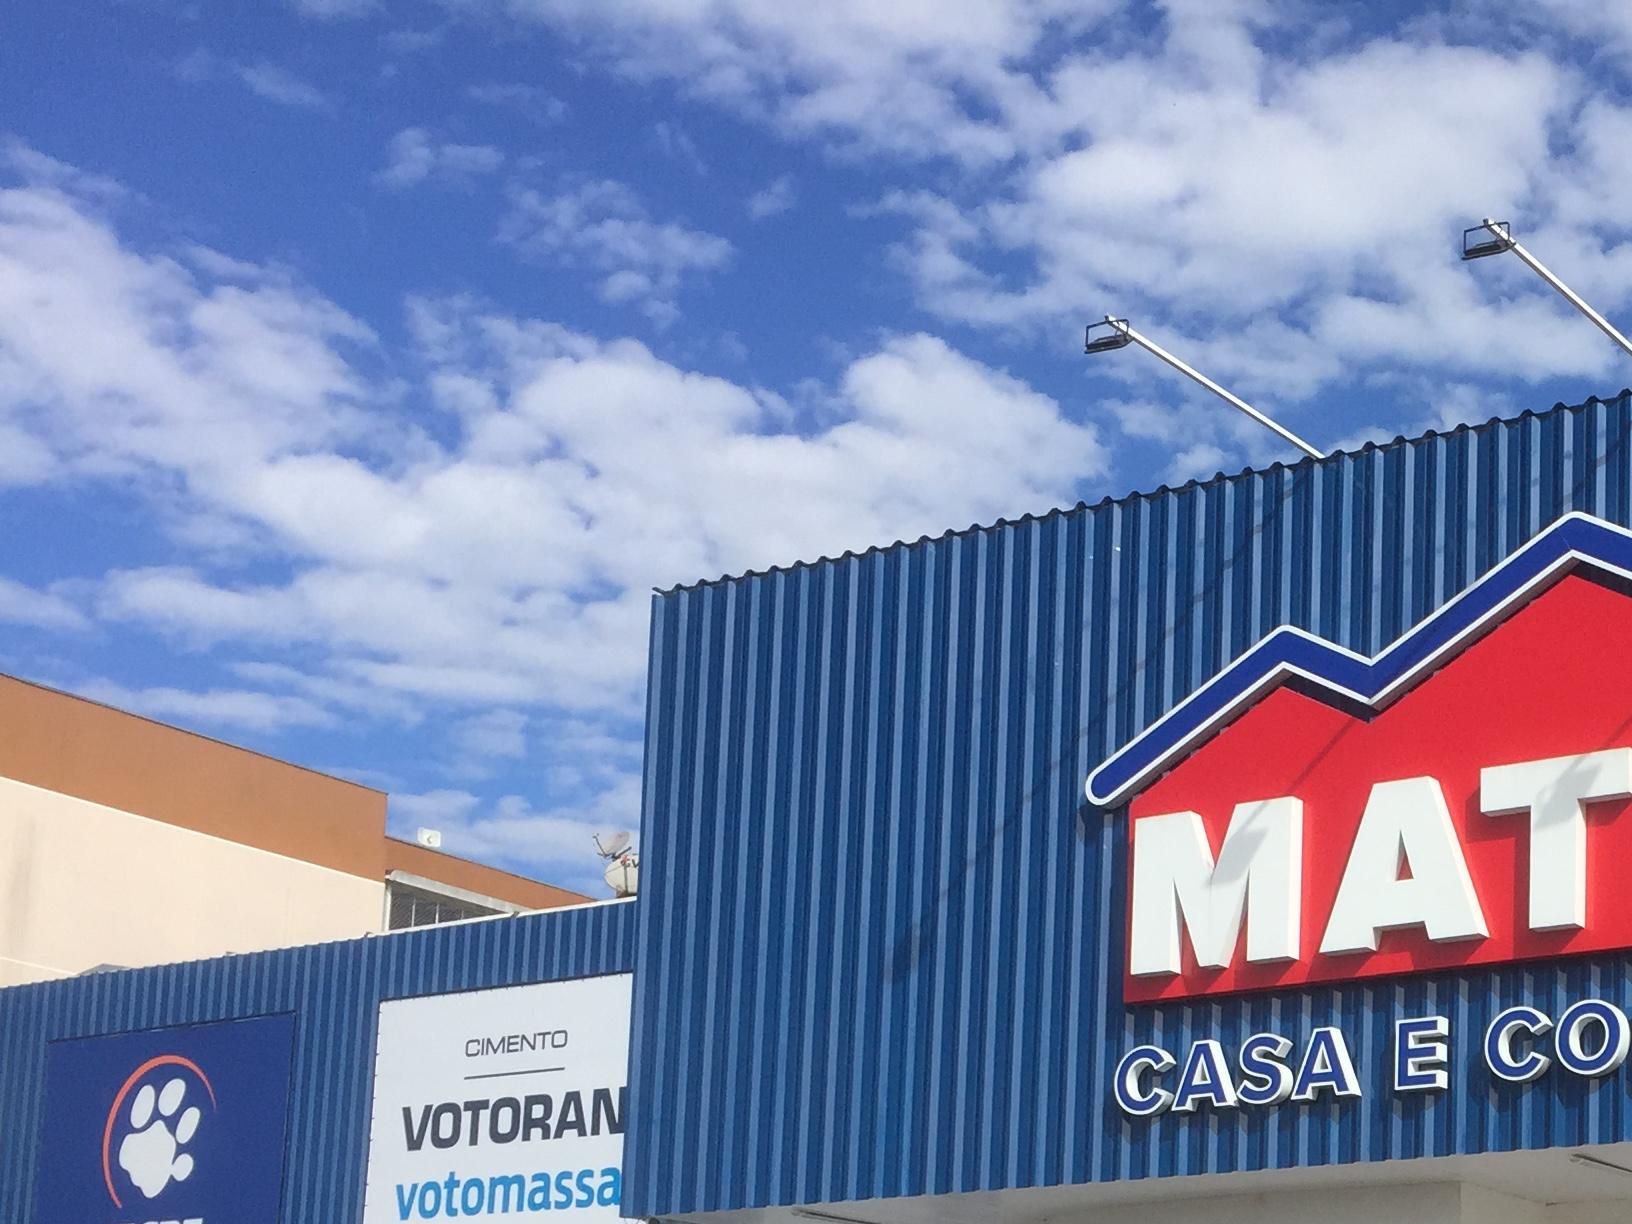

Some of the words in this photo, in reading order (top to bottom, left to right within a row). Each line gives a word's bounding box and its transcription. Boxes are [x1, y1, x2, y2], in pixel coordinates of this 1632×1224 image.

[464, 1029, 569, 1058] CIMENTO
[1114, 1024, 1363, 1118] CASA
[1394, 1015, 1449, 1092] E
[396, 1166, 622, 1221] votomassa
